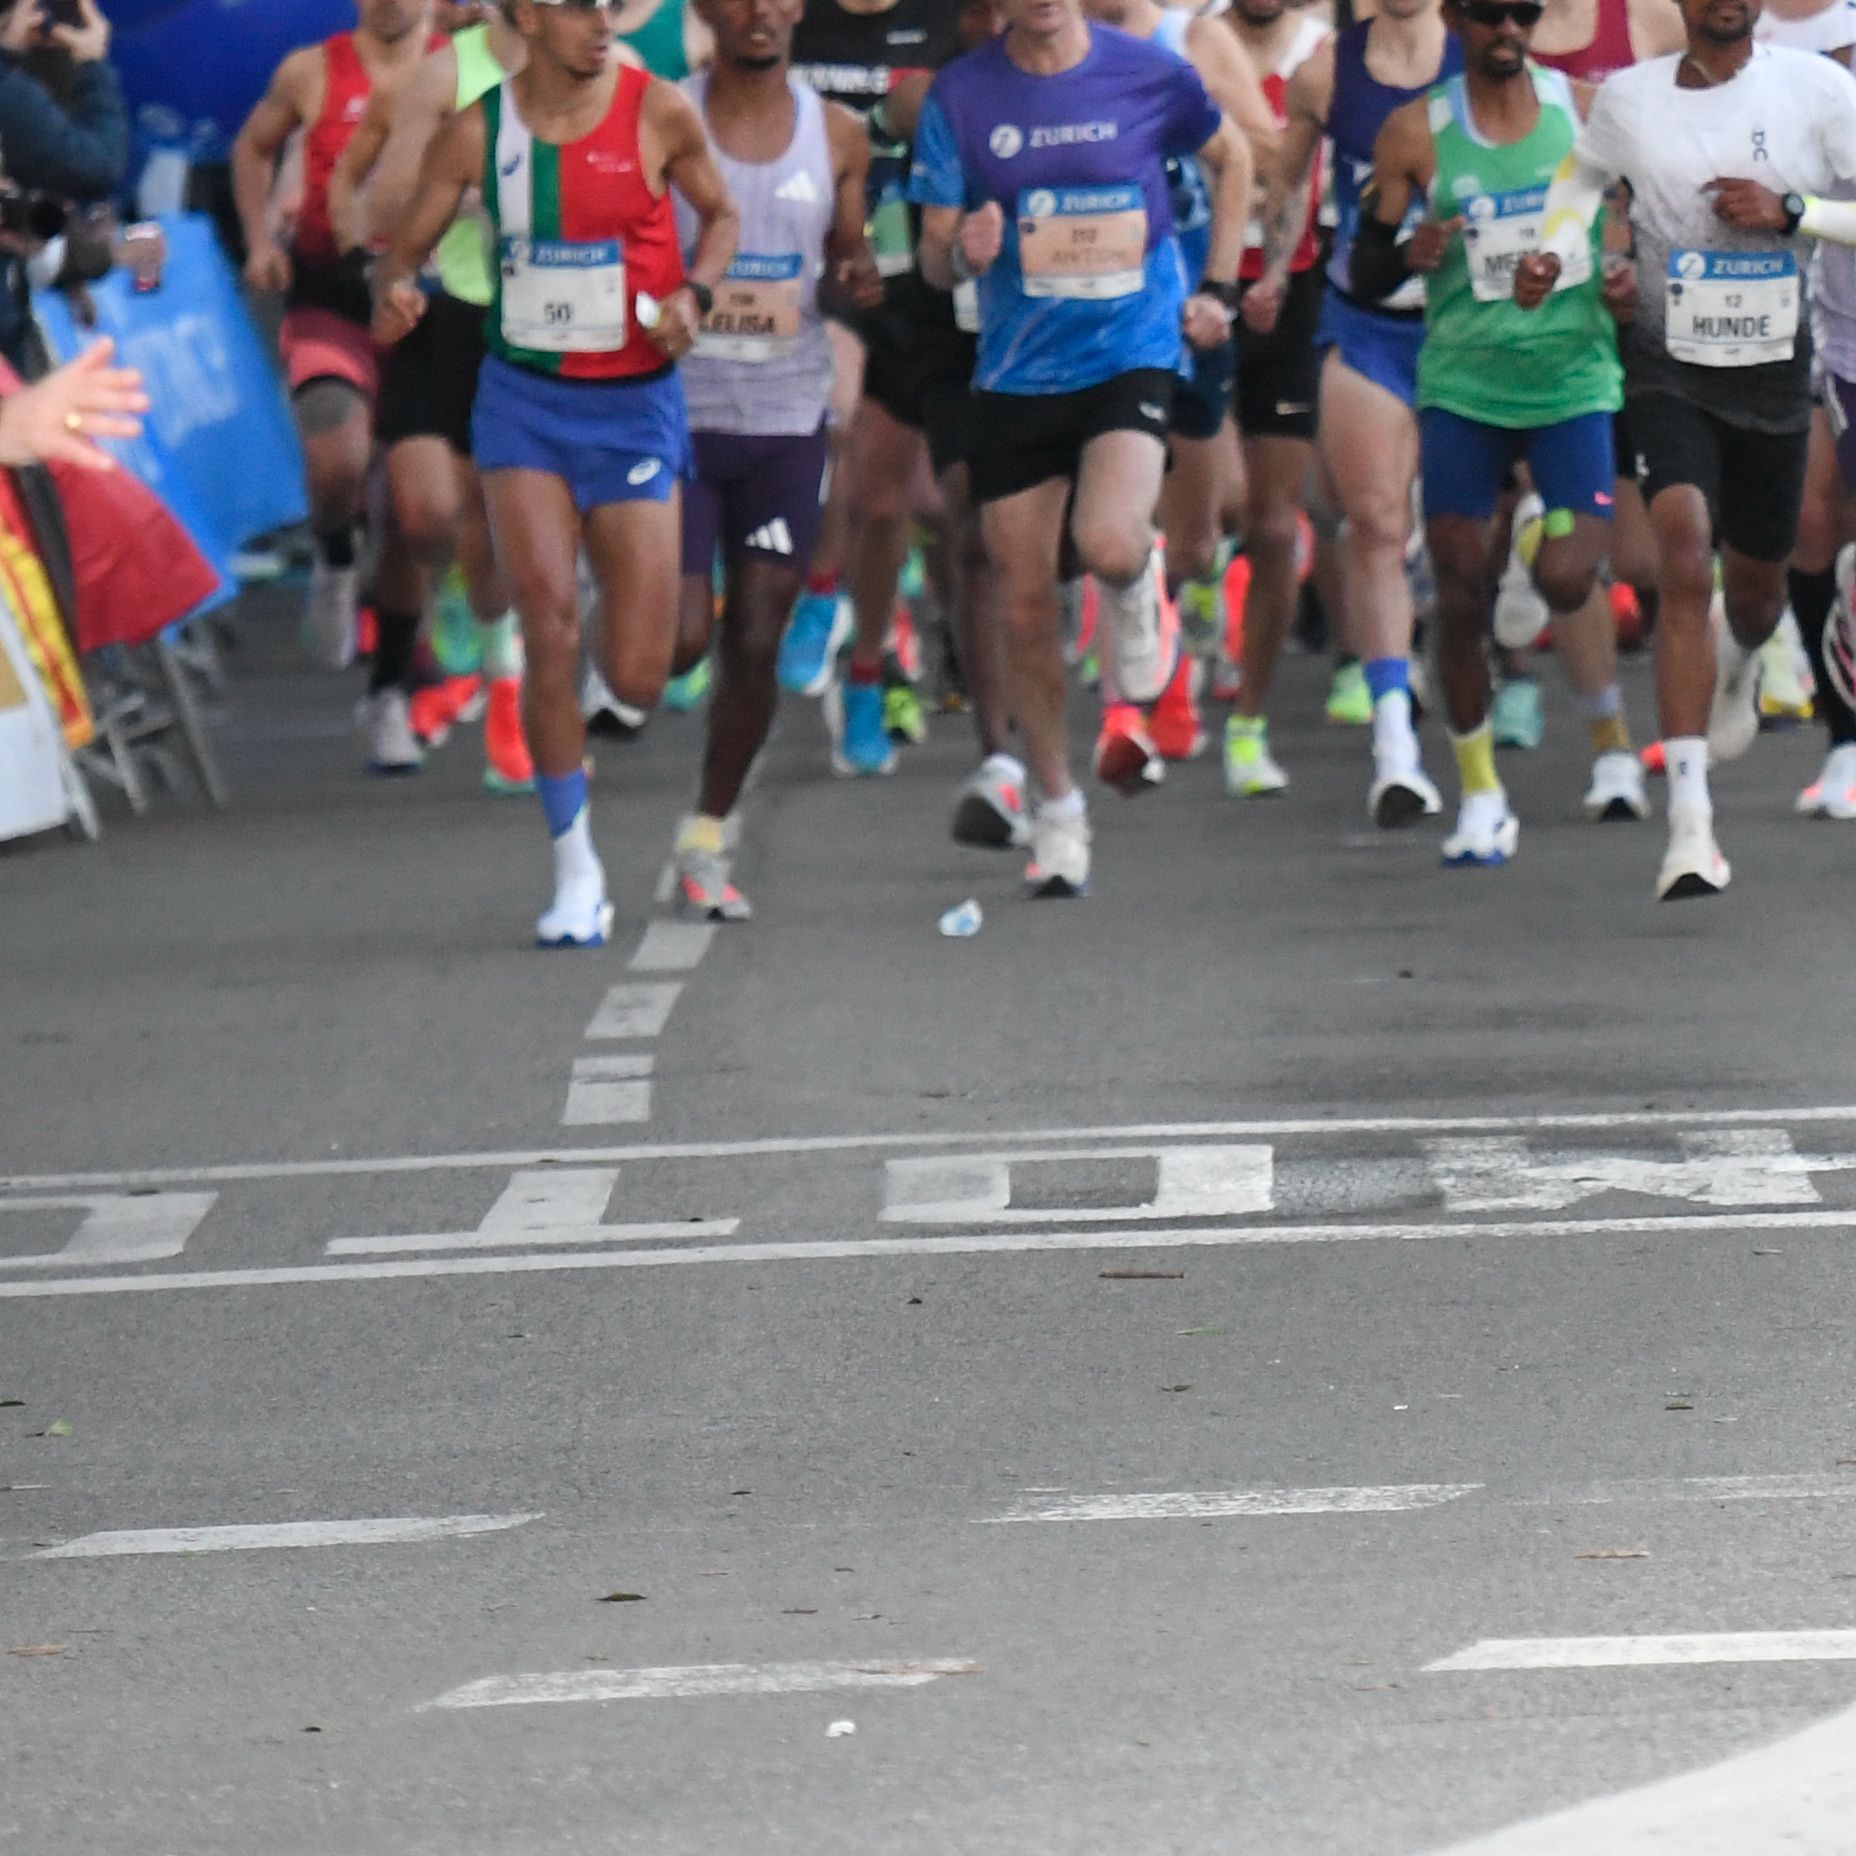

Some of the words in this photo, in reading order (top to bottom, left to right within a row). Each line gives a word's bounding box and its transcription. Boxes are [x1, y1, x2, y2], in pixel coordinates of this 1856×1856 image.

[1030, 121, 1118, 148] ZURICH
[1711, 257, 1785, 275] ZURICH
[543, 303, 572, 324] 50
[1692, 315, 1771, 339] HUNDE
